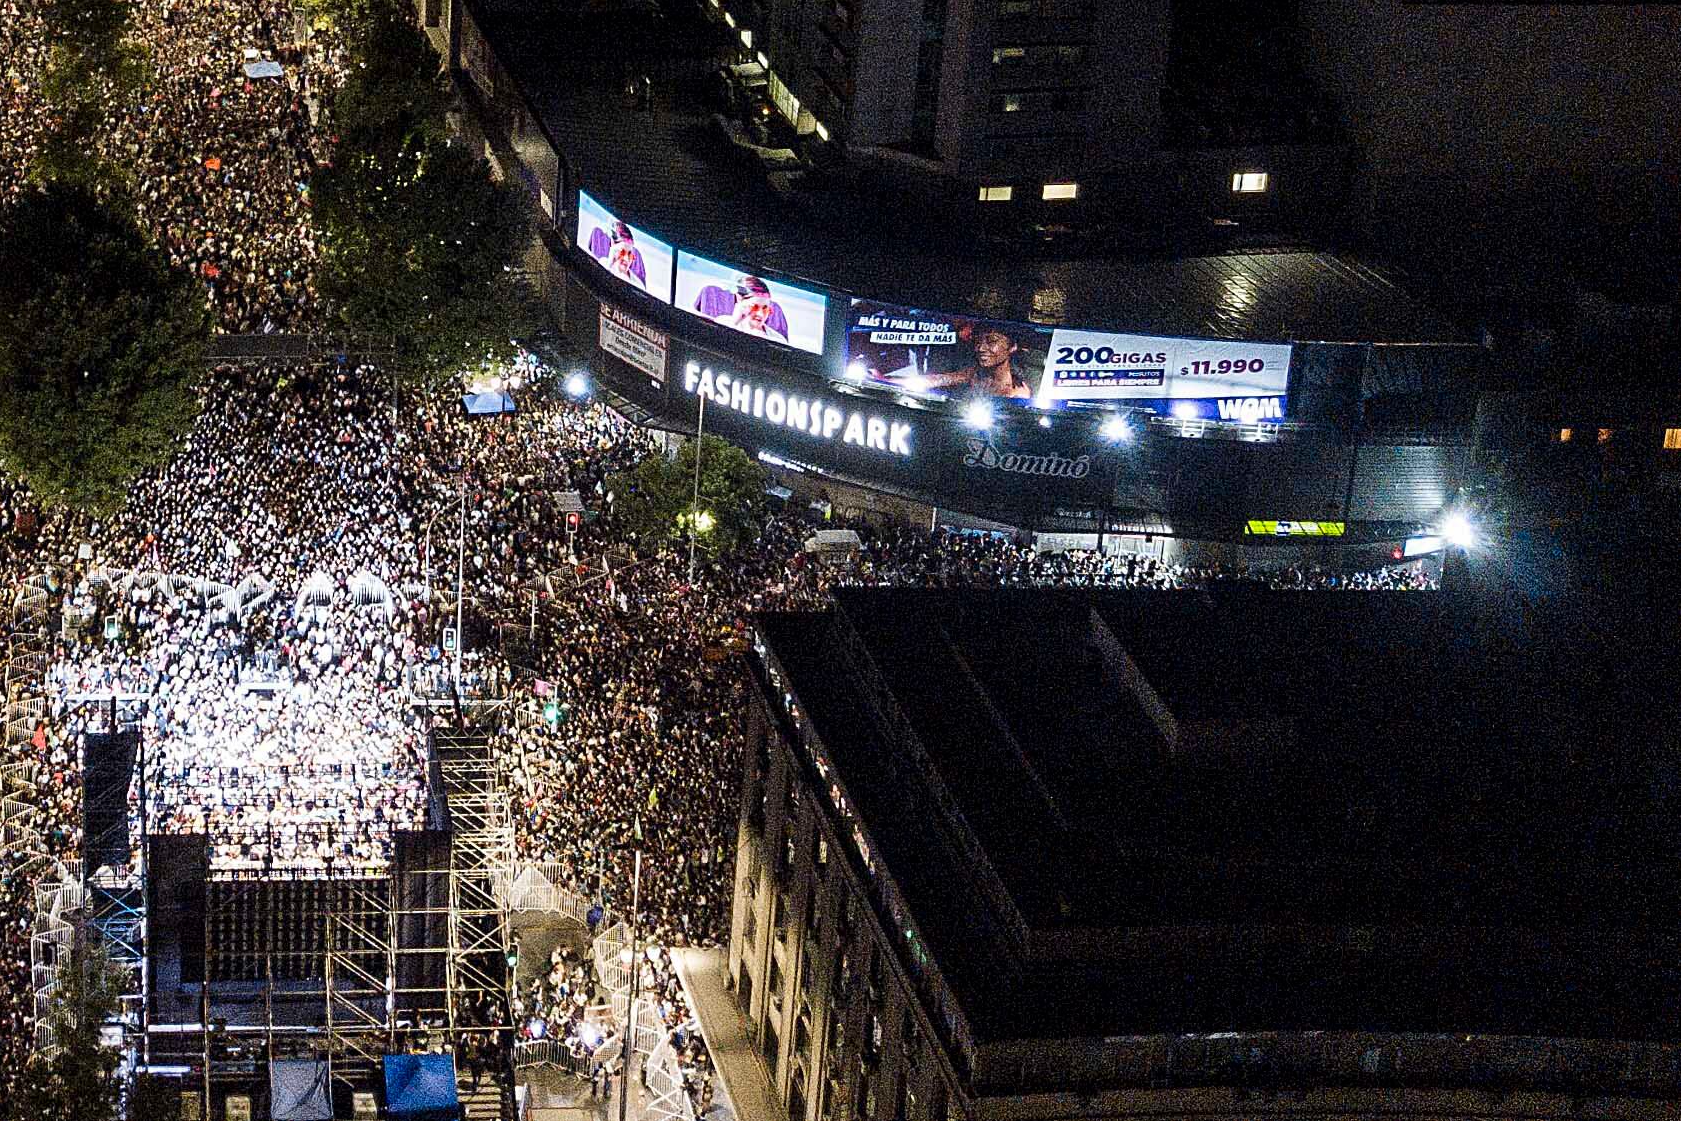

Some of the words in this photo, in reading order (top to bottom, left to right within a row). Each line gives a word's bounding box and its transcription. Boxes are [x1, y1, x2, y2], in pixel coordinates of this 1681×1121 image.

[859, 315, 880, 326] MÁS
[882, 319, 889, 328] Y
[890, 320, 916, 330] PARA
[918, 321, 949, 333] TODOS
[1219, 397, 1283, 423] WOM
[963, 436, 1090, 479] Dominó
